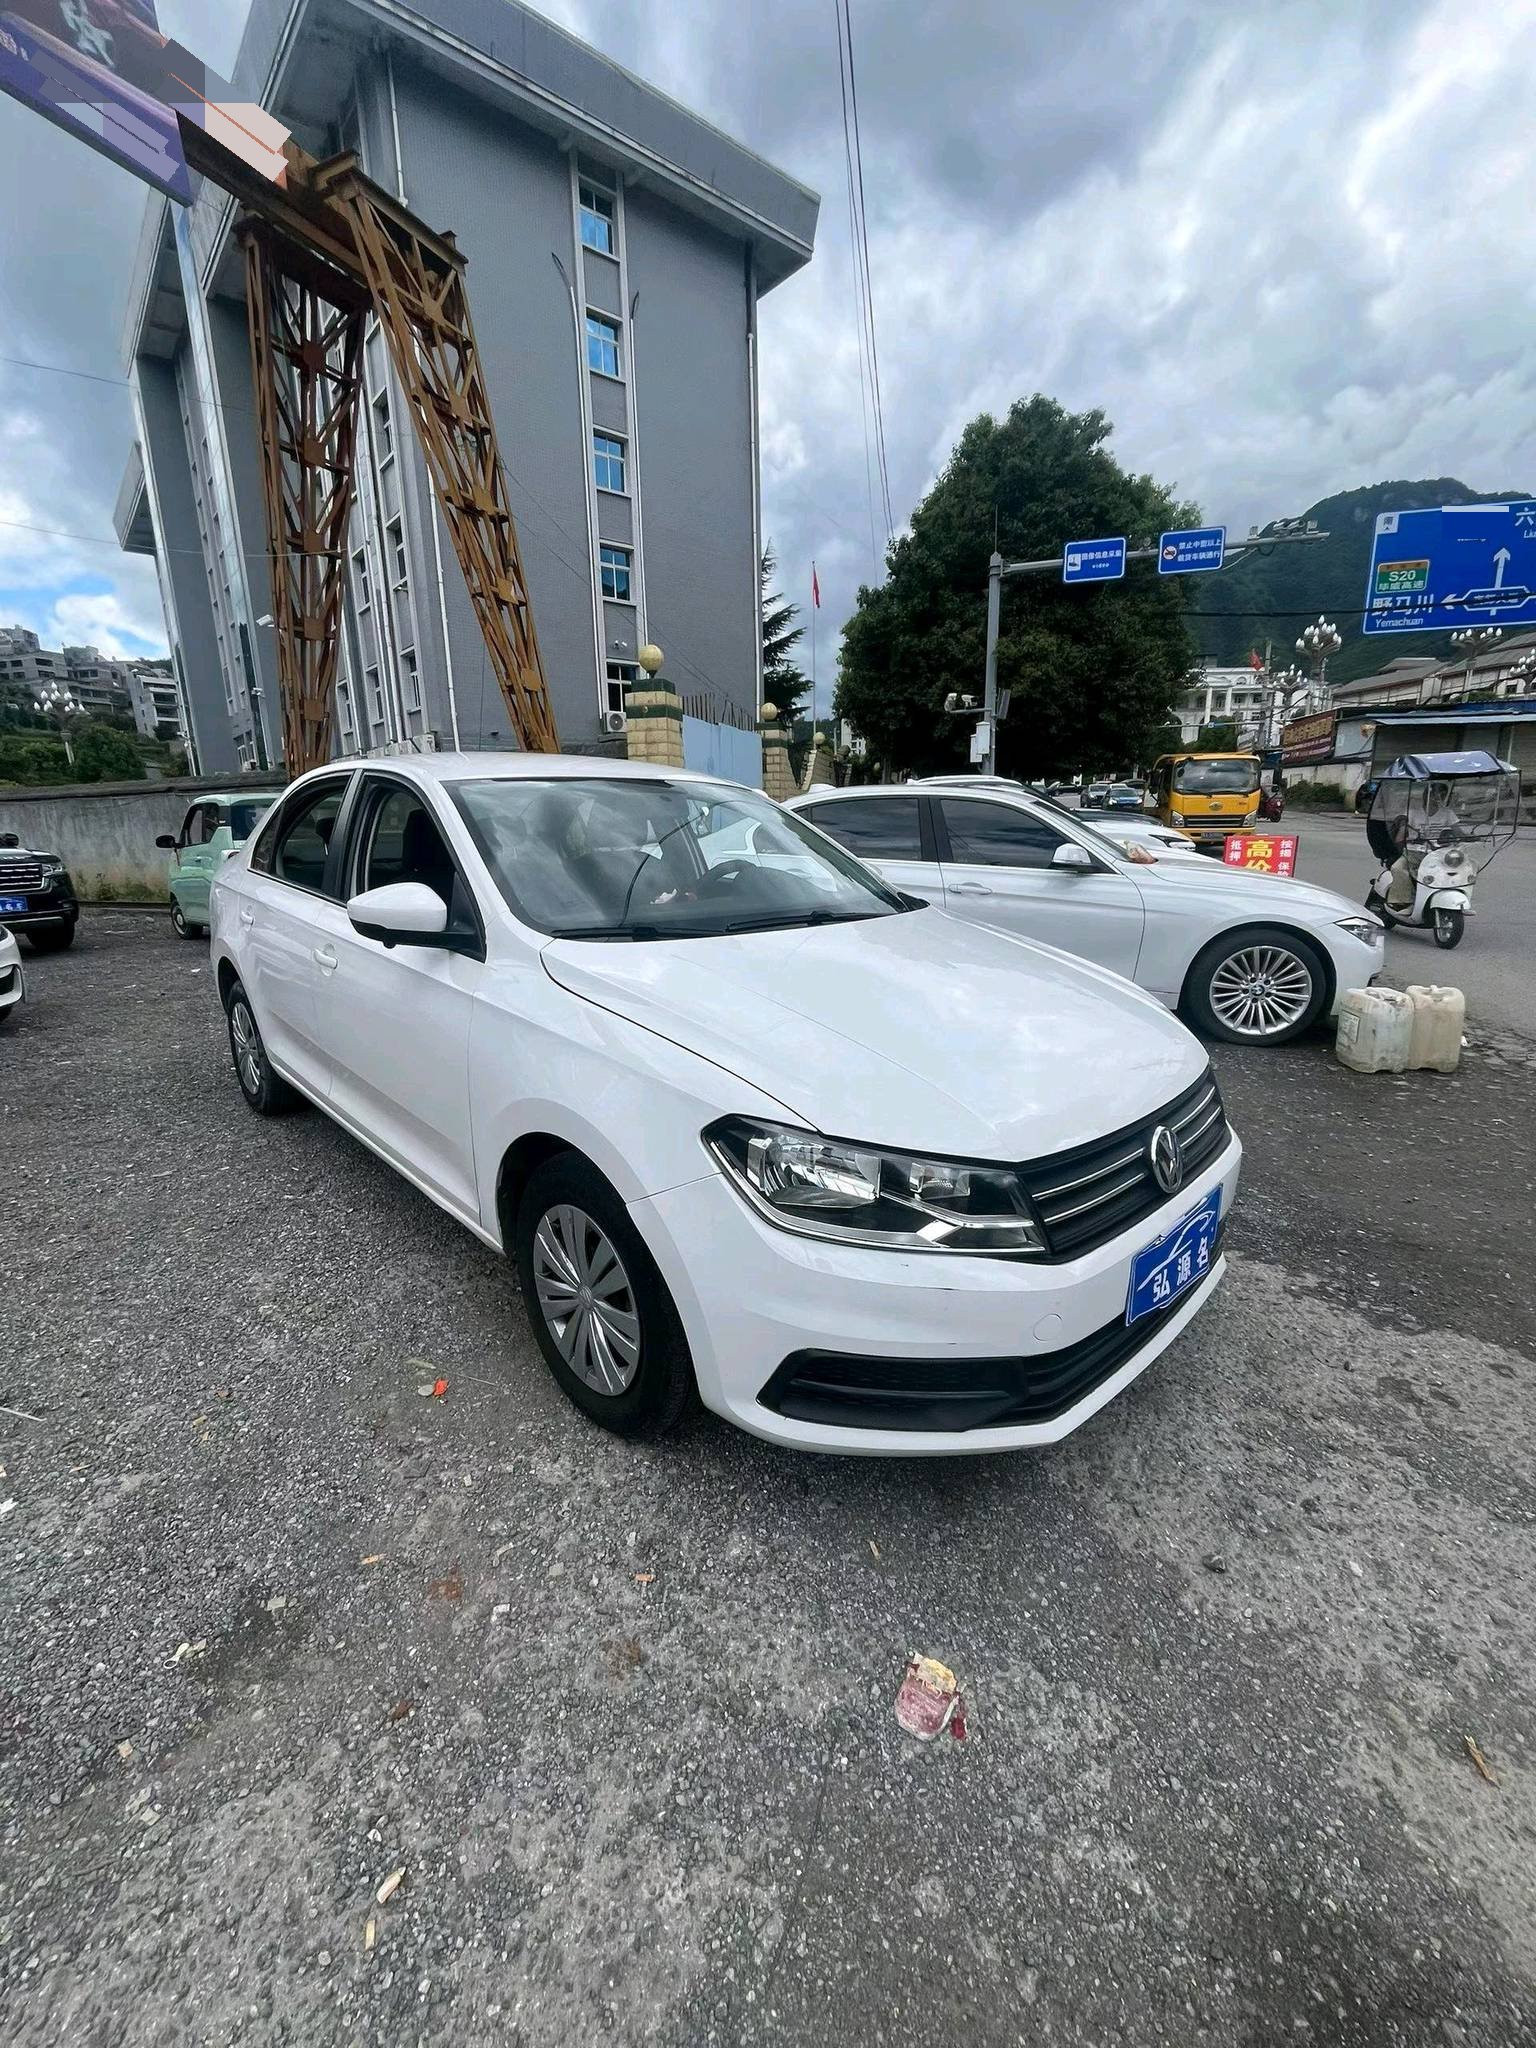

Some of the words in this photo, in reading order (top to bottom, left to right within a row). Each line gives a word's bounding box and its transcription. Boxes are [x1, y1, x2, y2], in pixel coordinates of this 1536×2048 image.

[1514, 507, 1536, 527] 六
[1178, 538, 1222, 550] 禁止中型以上
[1388, 570, 1417, 582] S20
[1375, 617, 1424, 628] Yemachuan
[1229, 839, 1242, 862] 抵押
[1244, 839, 1275, 872] 高价
[1279, 839, 1293, 858] 按揭
